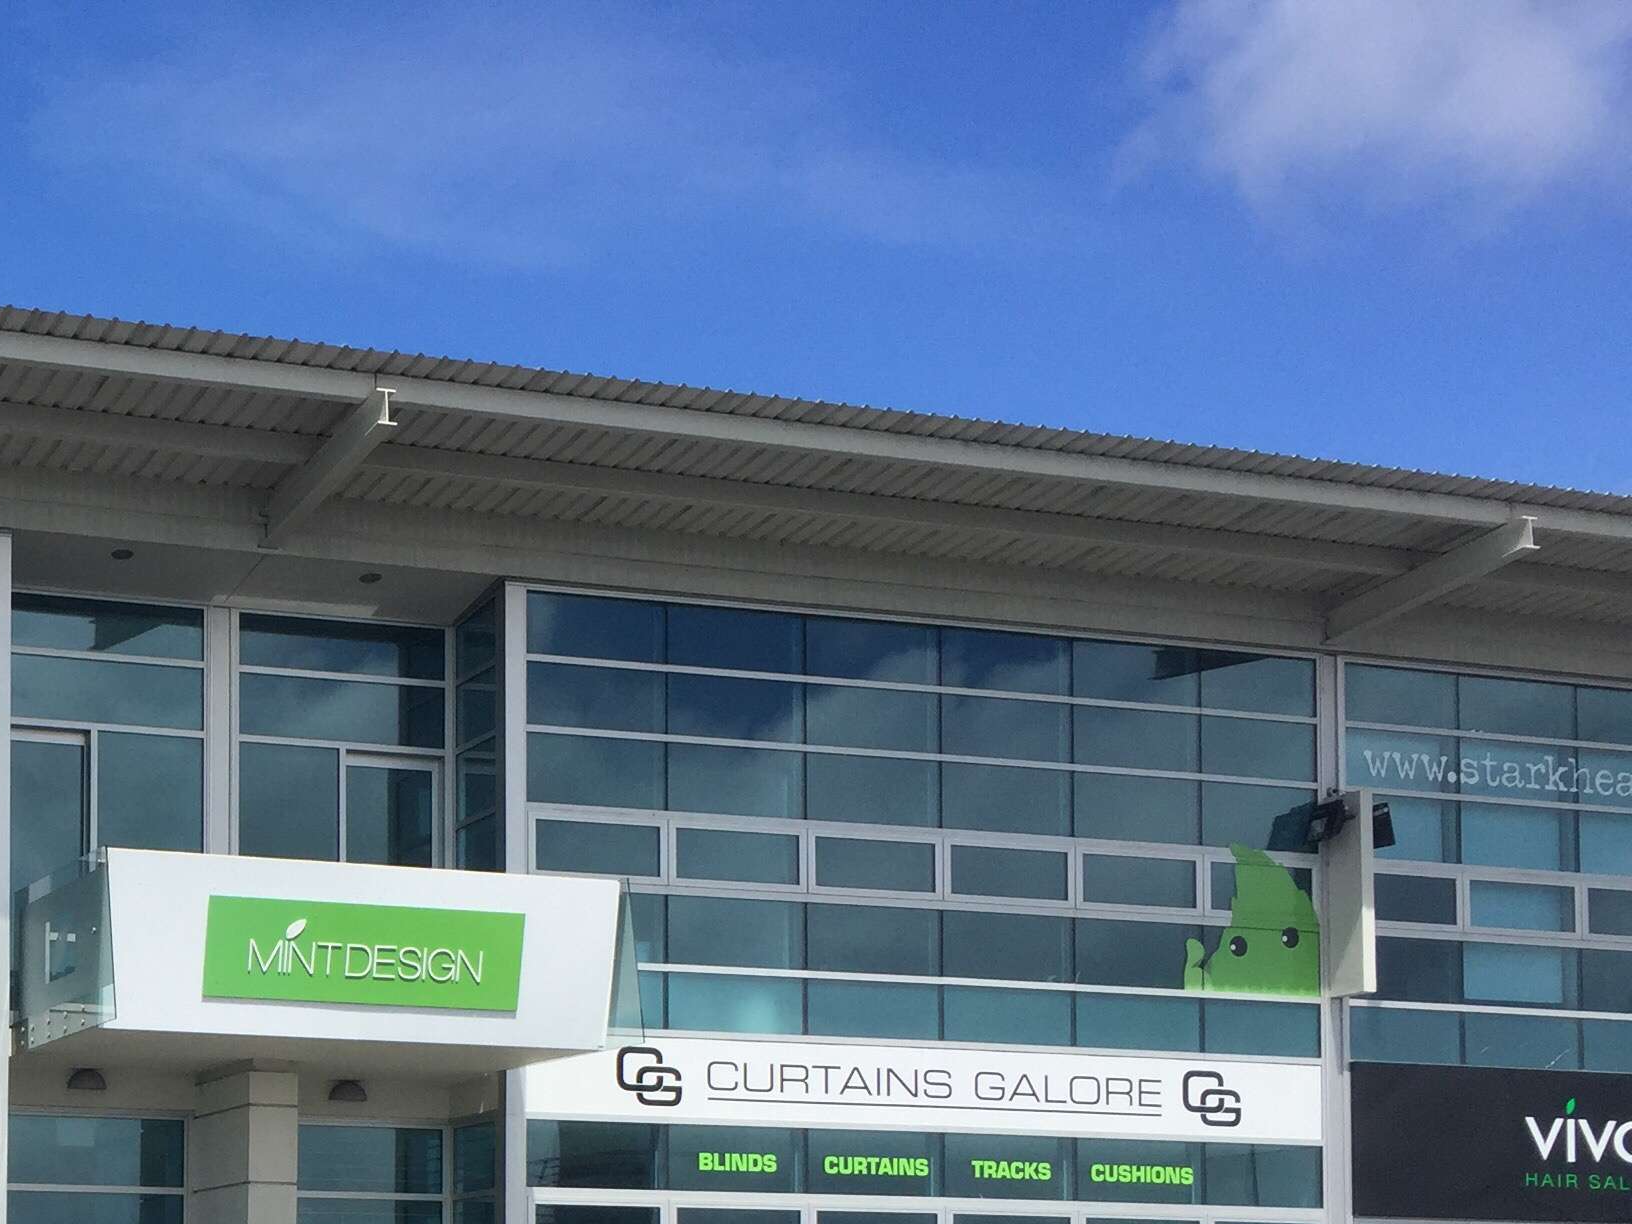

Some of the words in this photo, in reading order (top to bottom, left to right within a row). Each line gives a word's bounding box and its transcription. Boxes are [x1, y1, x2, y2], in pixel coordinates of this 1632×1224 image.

[706, 1060, 953, 1100] CURTAINS
[973, 1071, 1163, 1108] GALORE
[697, 1152, 778, 1173] BLINDS
[823, 1155, 930, 1177] CURTAINS
[970, 1160, 1053, 1180] TRACKS
[1090, 1163, 1194, 1185] CUSHIONS
[1525, 1172, 1580, 1189] HAIR
